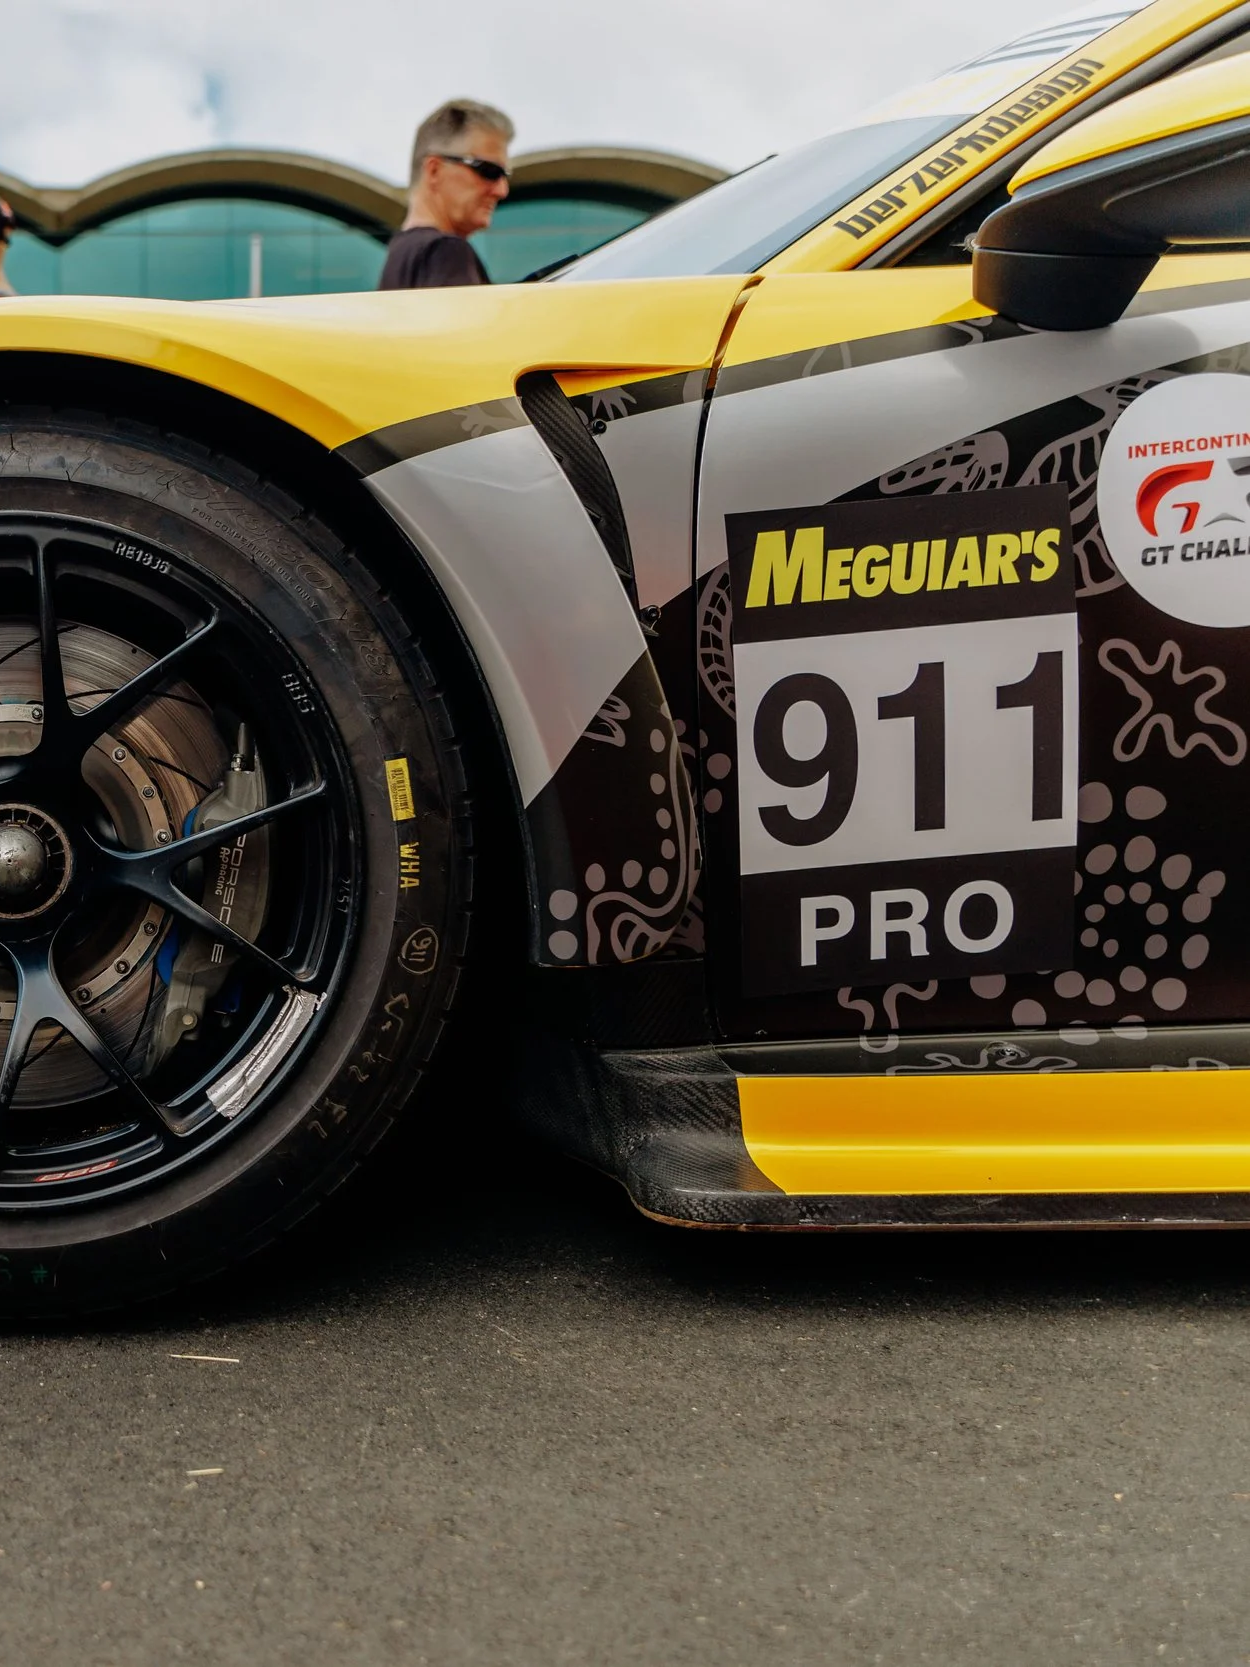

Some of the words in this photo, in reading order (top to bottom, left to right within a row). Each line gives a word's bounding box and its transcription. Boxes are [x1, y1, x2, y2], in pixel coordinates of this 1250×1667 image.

[834, 58, 1105, 240] berzerkdesign
[191, 506, 213, 523] FOR
[213, 518, 277, 569] COMPETITION
[276, 565, 294, 585] USE
[745, 527, 1060, 608] MEGUIAR'S
[1141, 545, 1174, 567] GT
[1180, 535, 1250, 562] CHAL
[753, 650, 1063, 847] 911
[211, 834, 247, 964] PORSCE
[398, 841, 421, 889] WHA
[801, 880, 1014, 967] PRO
